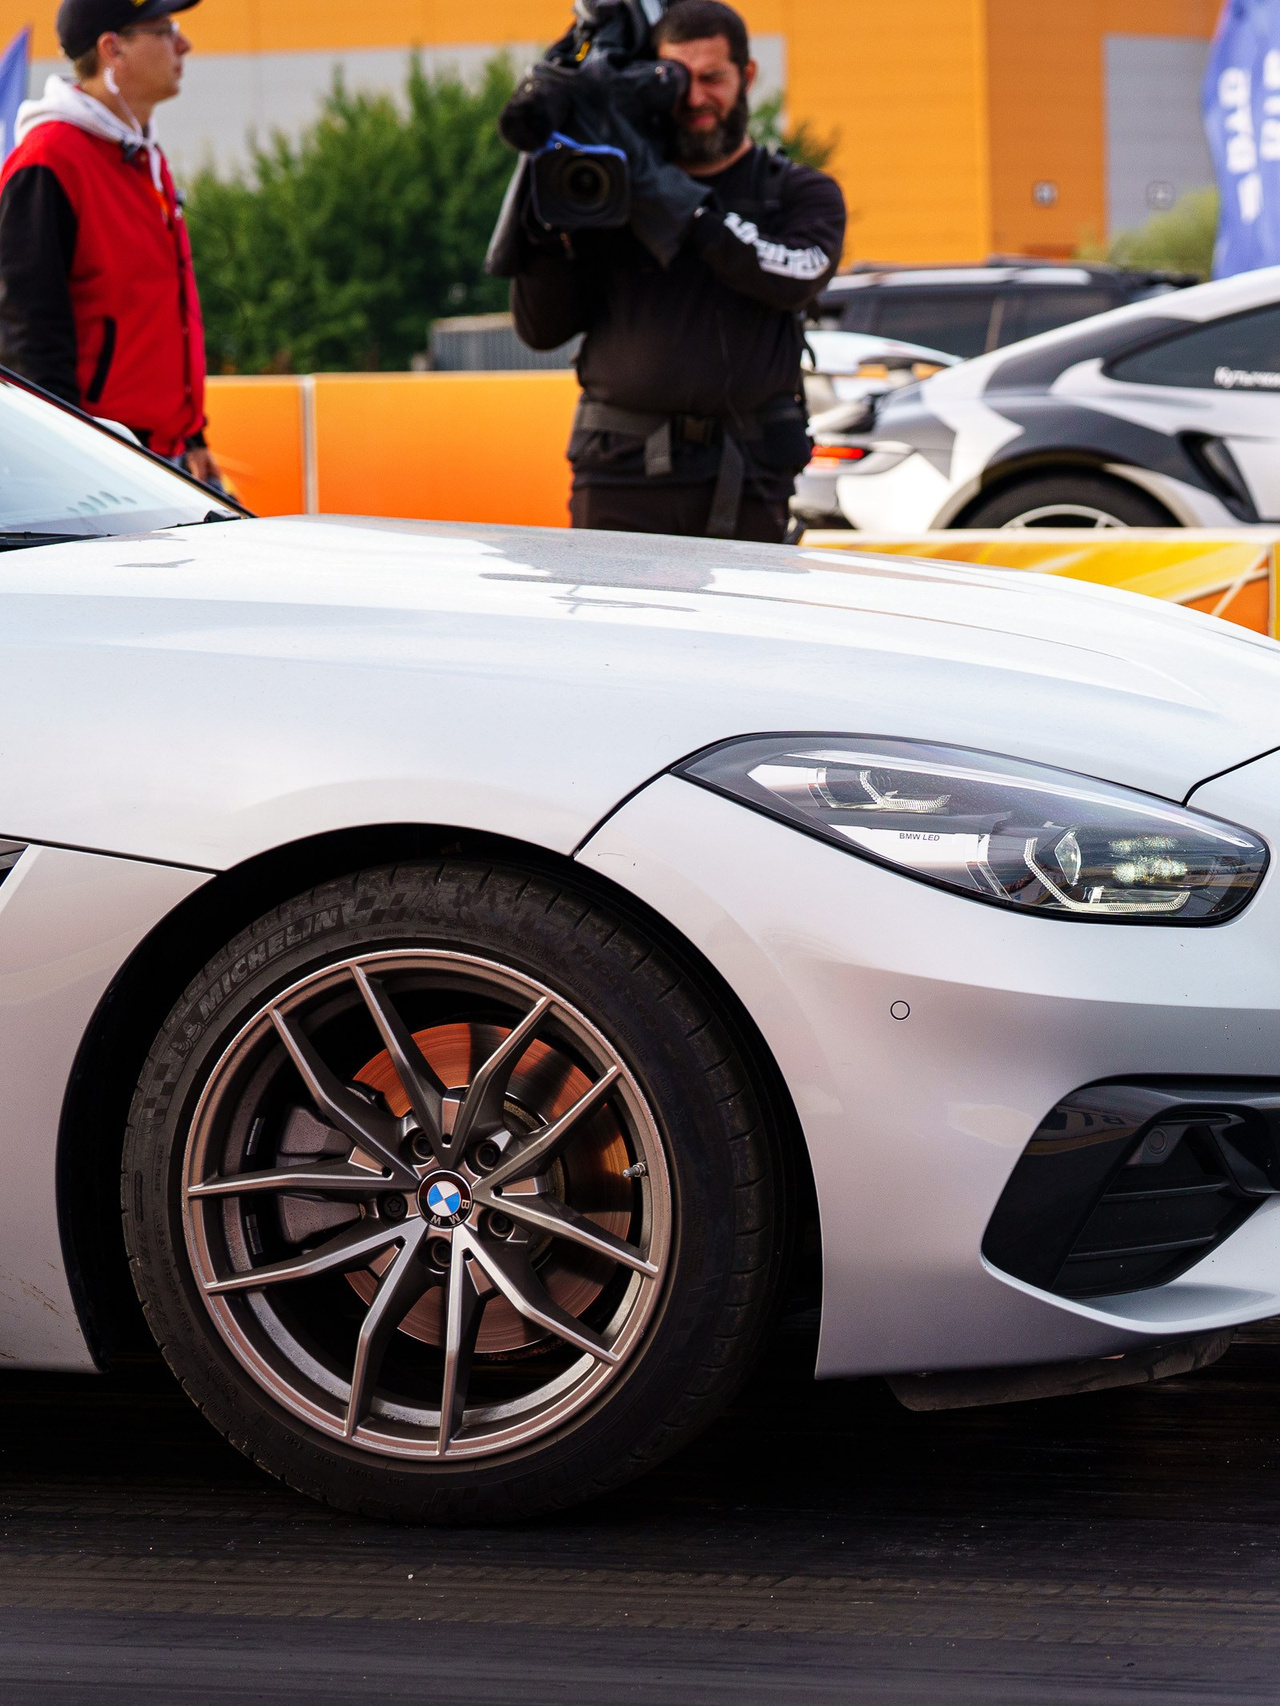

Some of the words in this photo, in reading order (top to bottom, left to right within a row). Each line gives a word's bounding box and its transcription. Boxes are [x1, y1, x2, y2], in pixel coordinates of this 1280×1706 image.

[899, 832, 921, 840] BMW
[922, 834, 940, 842] LED
[198, 908, 340, 1017] MICHELIN
[430, 1199, 471, 1226] BMW
